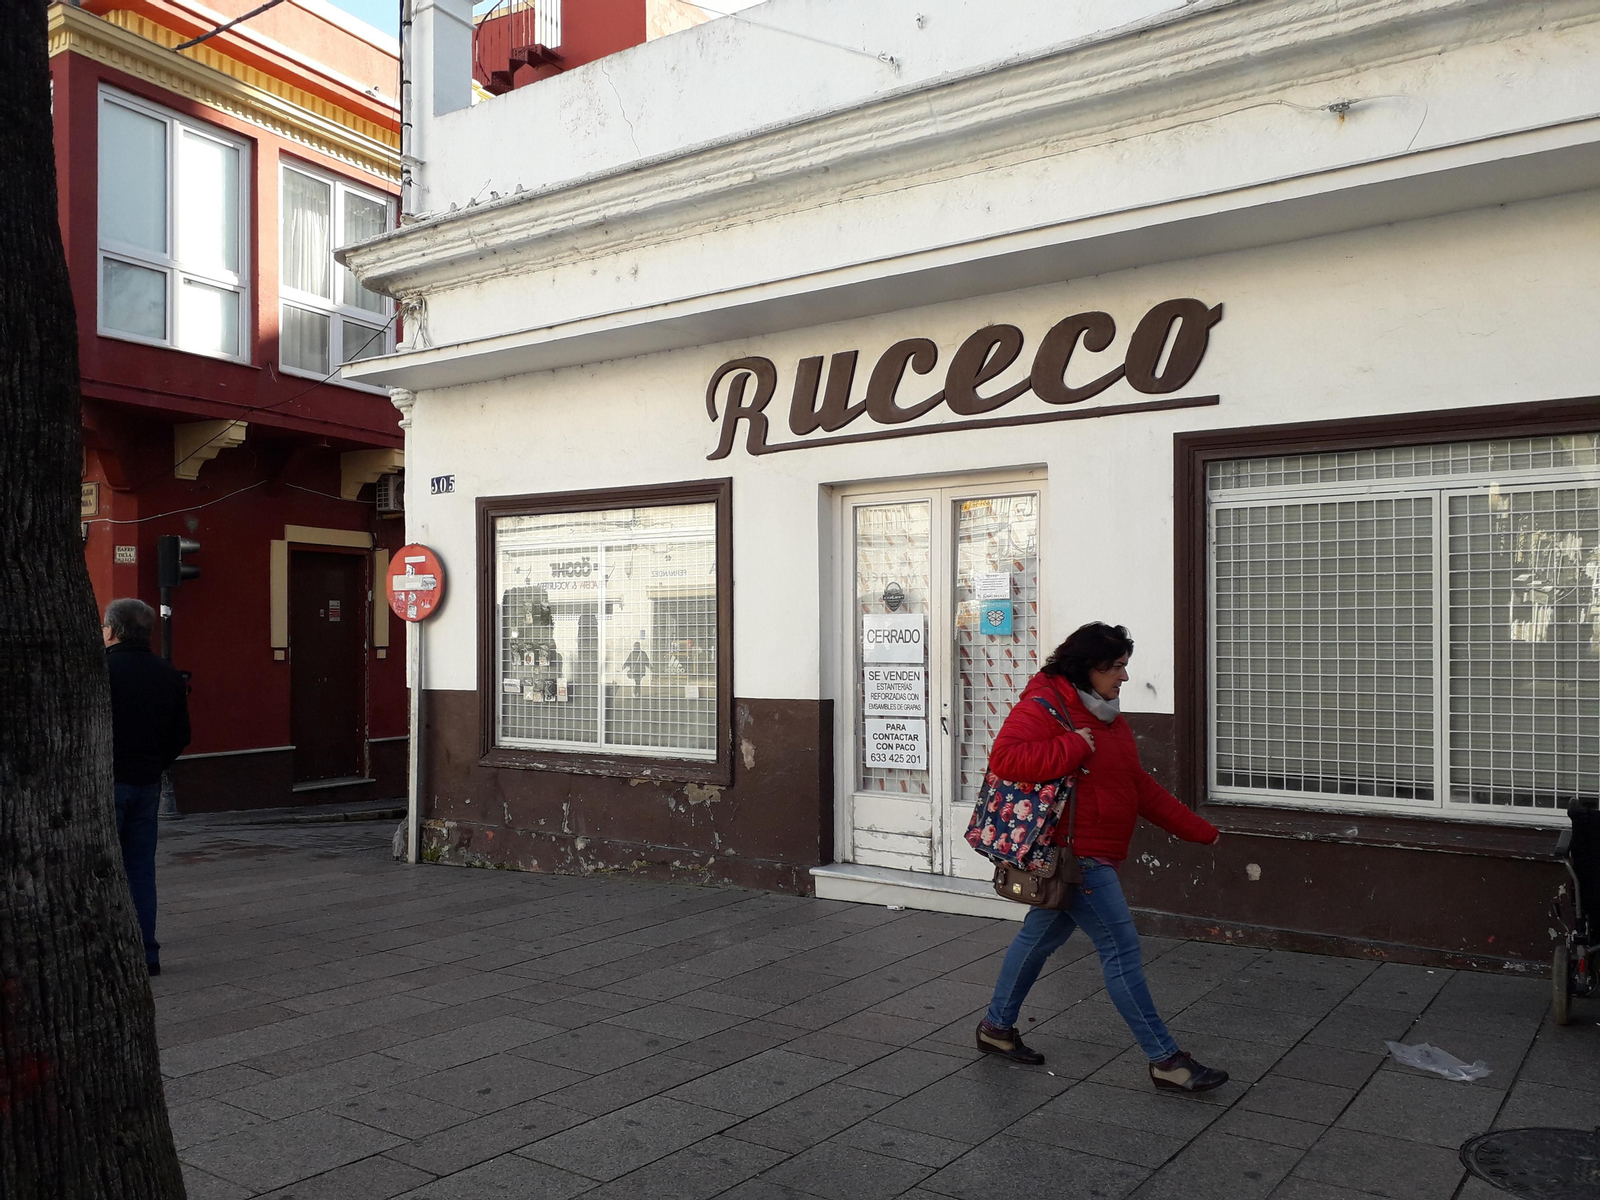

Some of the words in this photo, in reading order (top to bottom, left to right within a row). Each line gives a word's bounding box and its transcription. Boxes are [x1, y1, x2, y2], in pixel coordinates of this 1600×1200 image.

[706, 298, 1223, 460] Ruceco
[431, 476, 455, 493] 105
[867, 629, 920, 644] CERRADO
[868, 671, 881, 681] SE
[883, 671, 920, 681] VENDEN
[907, 693, 919, 701] CON
[904, 703, 922, 711] GRAPAS
[886, 723, 906, 731] PARA
[872, 733, 919, 741] CONTACTAR
[895, 743, 915, 751] PACO
[870, 752, 886, 762] 633
[889, 753, 904, 763] 425
[906, 754, 921, 764] 201
